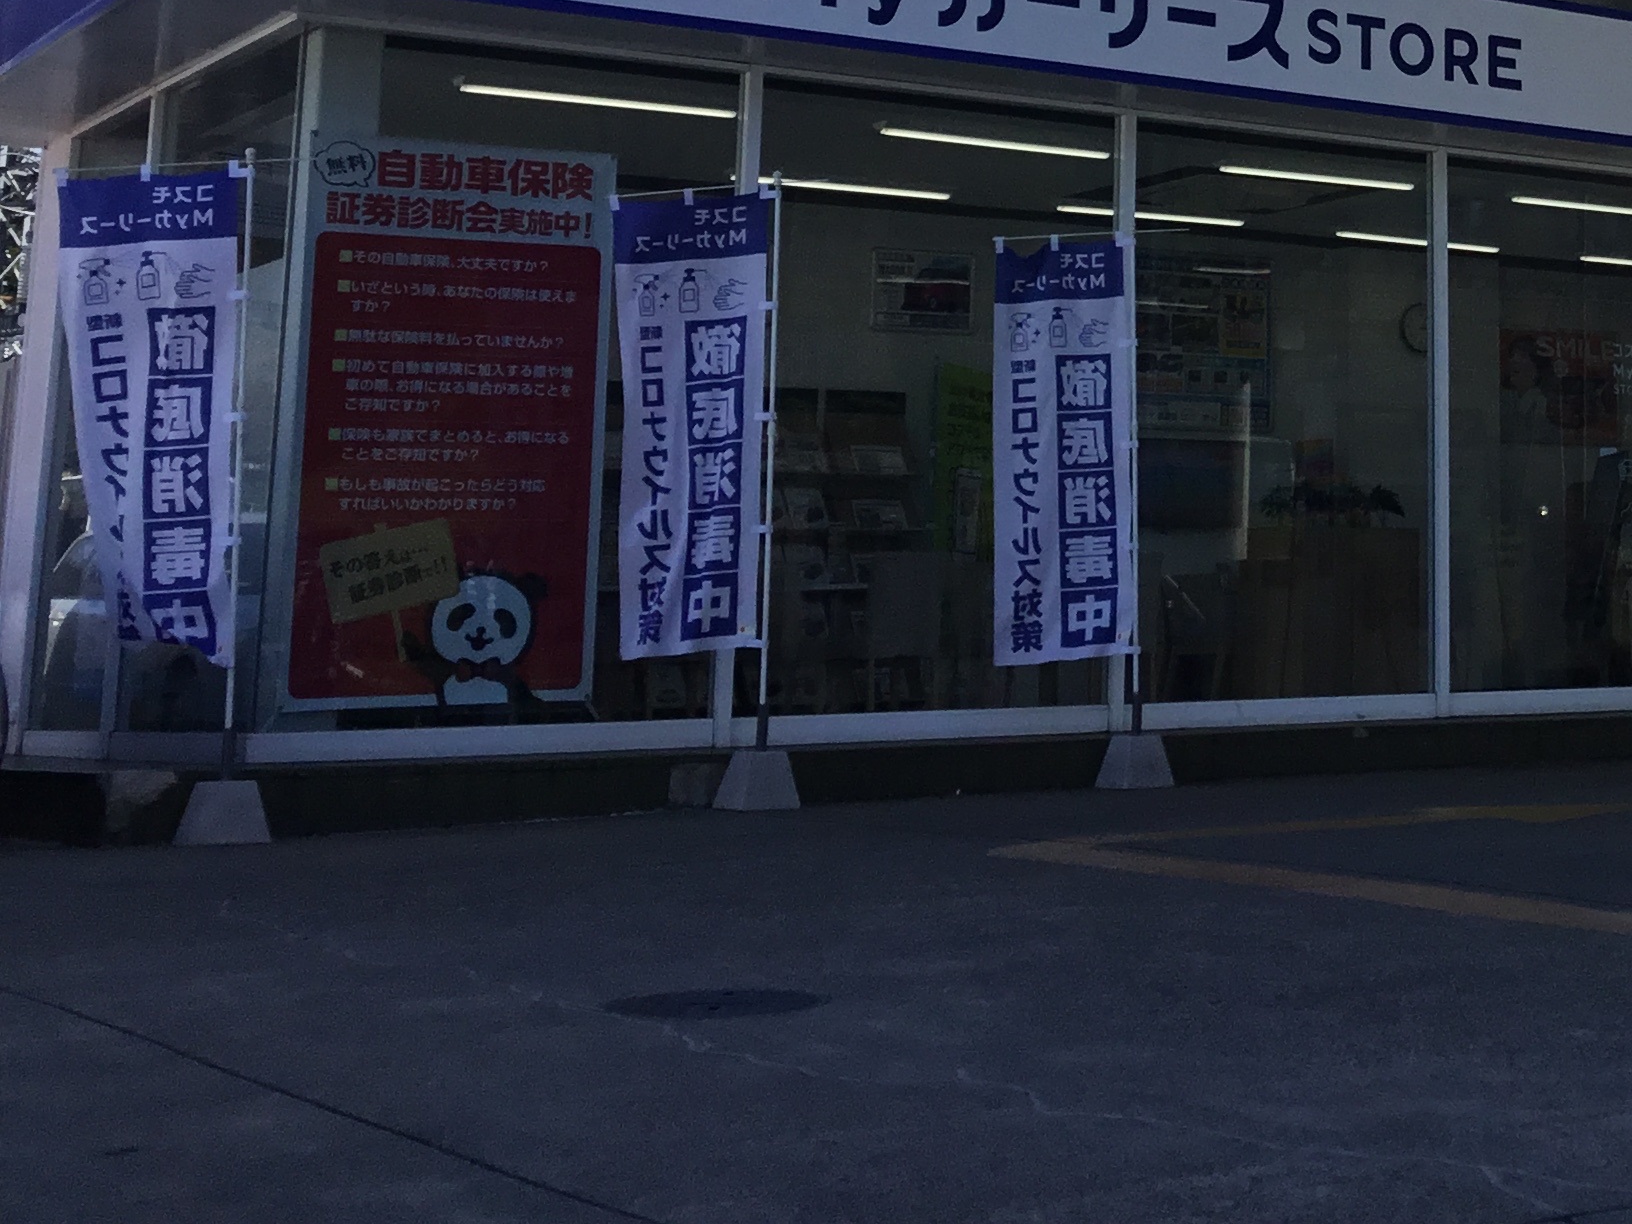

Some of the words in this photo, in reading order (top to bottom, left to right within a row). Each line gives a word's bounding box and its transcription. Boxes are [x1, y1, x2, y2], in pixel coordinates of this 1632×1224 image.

[1308, 5, 1525, 92] STORE
[326, 152, 368, 176] 無料
[377, 149, 594, 202] 自動車保険
[326, 190, 592, 240] 証券診断会実施中！
[1536, 335, 1614, 360] SMILE
